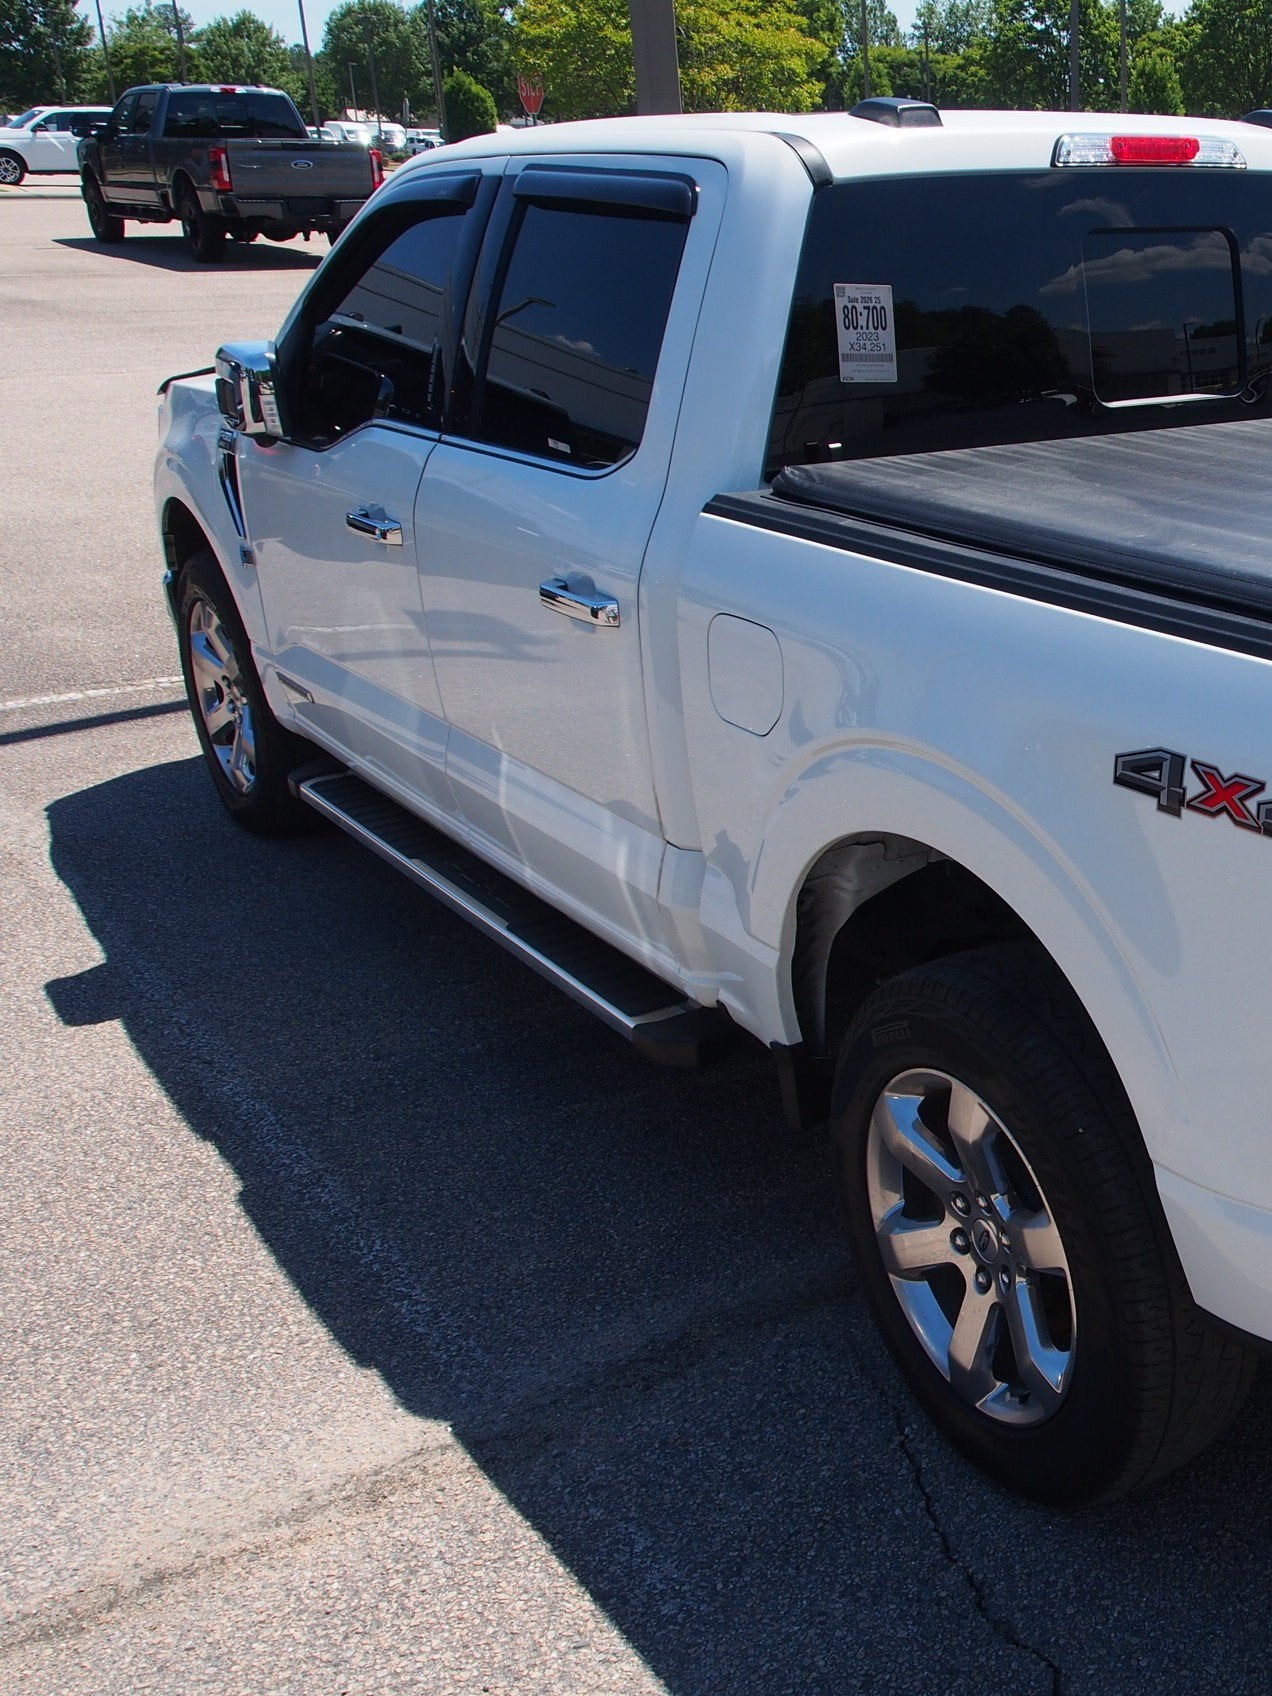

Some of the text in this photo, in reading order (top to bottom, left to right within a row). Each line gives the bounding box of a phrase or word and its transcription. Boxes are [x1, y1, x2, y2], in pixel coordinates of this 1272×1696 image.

[848, 296, 859, 304] Sale
[842, 304, 888, 331] 80:700
[856, 331, 880, 341] 2023
[871, 1020, 911, 1047] PIRELLI
